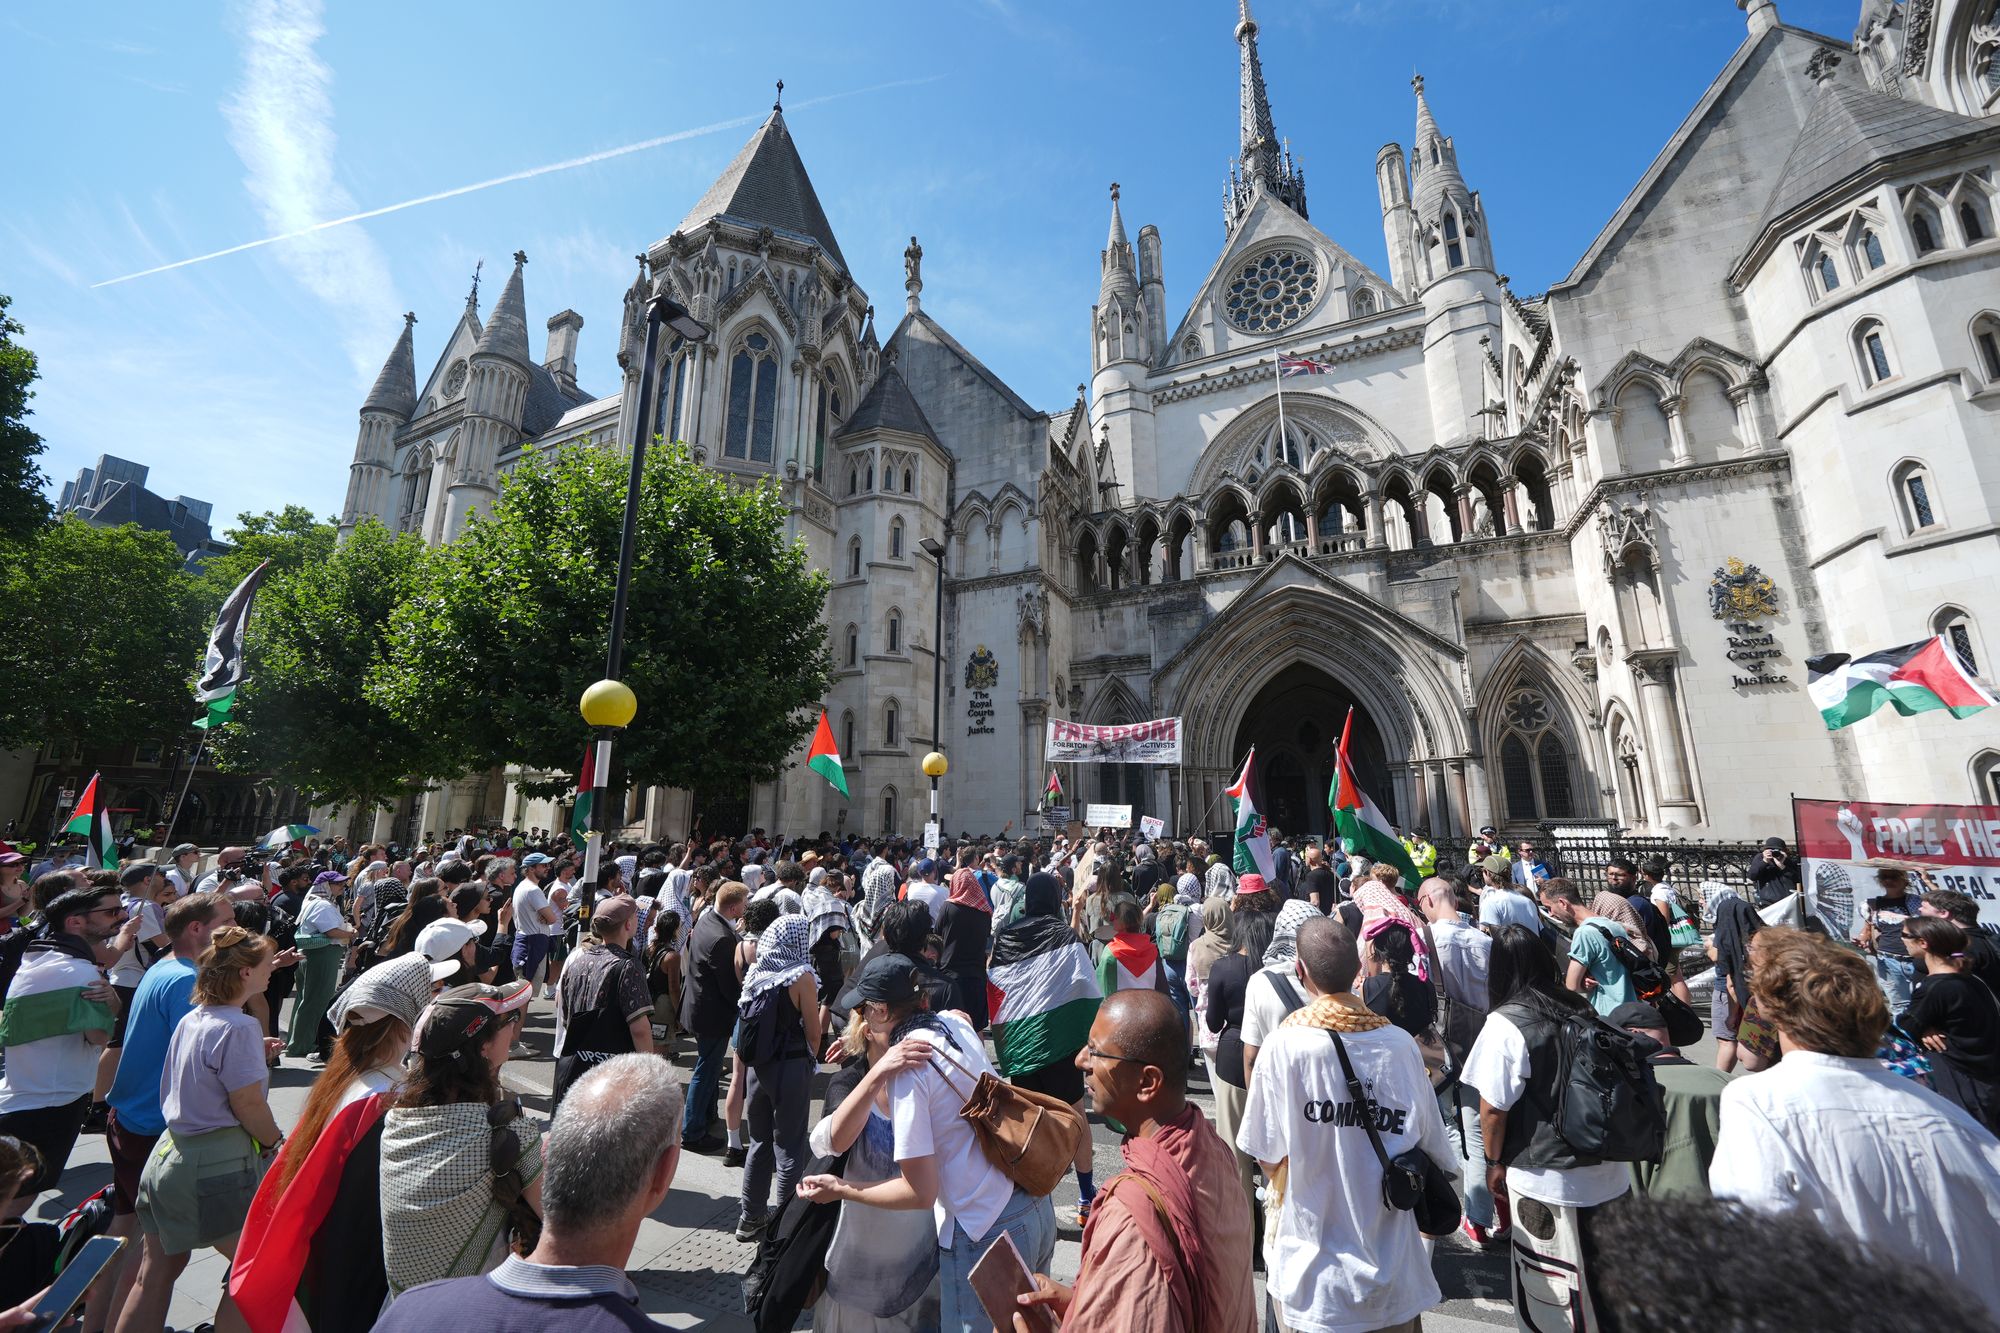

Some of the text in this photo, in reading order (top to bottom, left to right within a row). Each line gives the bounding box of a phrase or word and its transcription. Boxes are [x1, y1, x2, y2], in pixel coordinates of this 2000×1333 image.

[1729, 623, 1763, 635] The
[1726, 634, 1774, 649] Royal
[1726, 648, 1782, 662] Courts
[1746, 660, 1766, 673] of
[1732, 673, 1788, 690] Justice
[973, 691, 989, 699] The
[969, 699, 992, 710] Royal
[967, 709, 995, 717] Courts
[976, 716, 986, 725] of
[967, 725, 995, 736] Justice
[1053, 719, 1176, 742] FREEDOM
[1140, 741, 1176, 749] ACTIVISTS
[1142, 816, 1164, 827] JUSTICE
[1871, 816, 2000, 858] FREE THE
[1943, 874, 1996, 900] REAL
